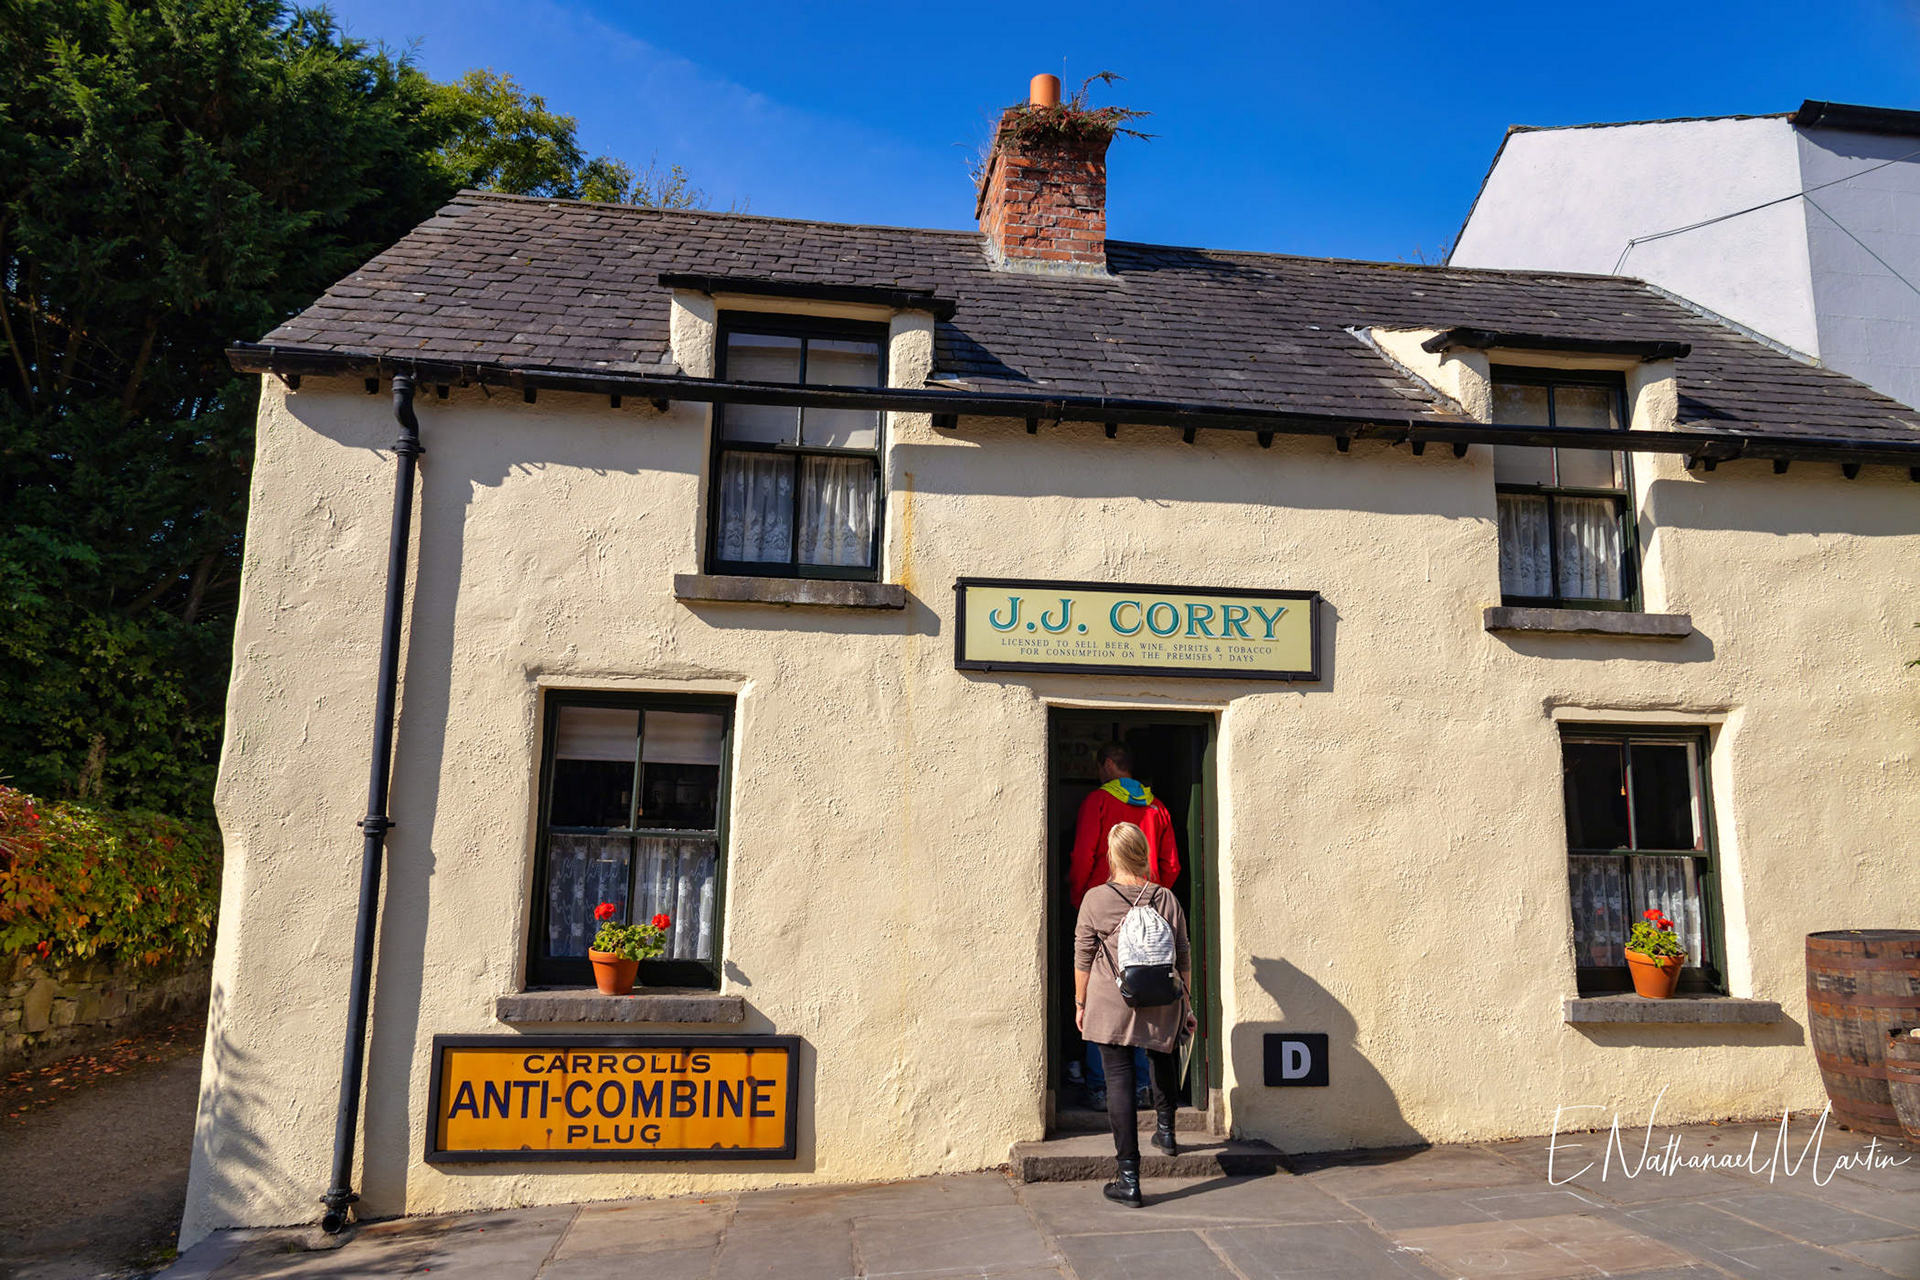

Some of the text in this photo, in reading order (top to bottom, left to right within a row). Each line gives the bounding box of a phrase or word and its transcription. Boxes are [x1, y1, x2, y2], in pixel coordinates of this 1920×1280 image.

[989, 596, 1288, 641] J.J. CORRY
[1001, 638, 1050, 647] LICENSED
[1057, 639, 1069, 647] TO
[1075, 640, 1098, 649] SELL
[1173, 644, 1209, 653] SPIRITS
[1228, 645, 1272, 655] TOBACCO
[1020, 647, 1039, 656] FOR
[1046, 648, 1115, 658] CONSUMPTION
[1121, 650, 1135, 658] ON
[1142, 651, 1160, 660] THE
[1166, 652, 1213, 661] PREMISES
[1229, 654, 1254, 663] DAYS
[1281, 1041, 1311, 1079] D
[447, 1079, 776, 1119] ANTI-COMBINE
[567, 1125, 661, 1144] PLUG
